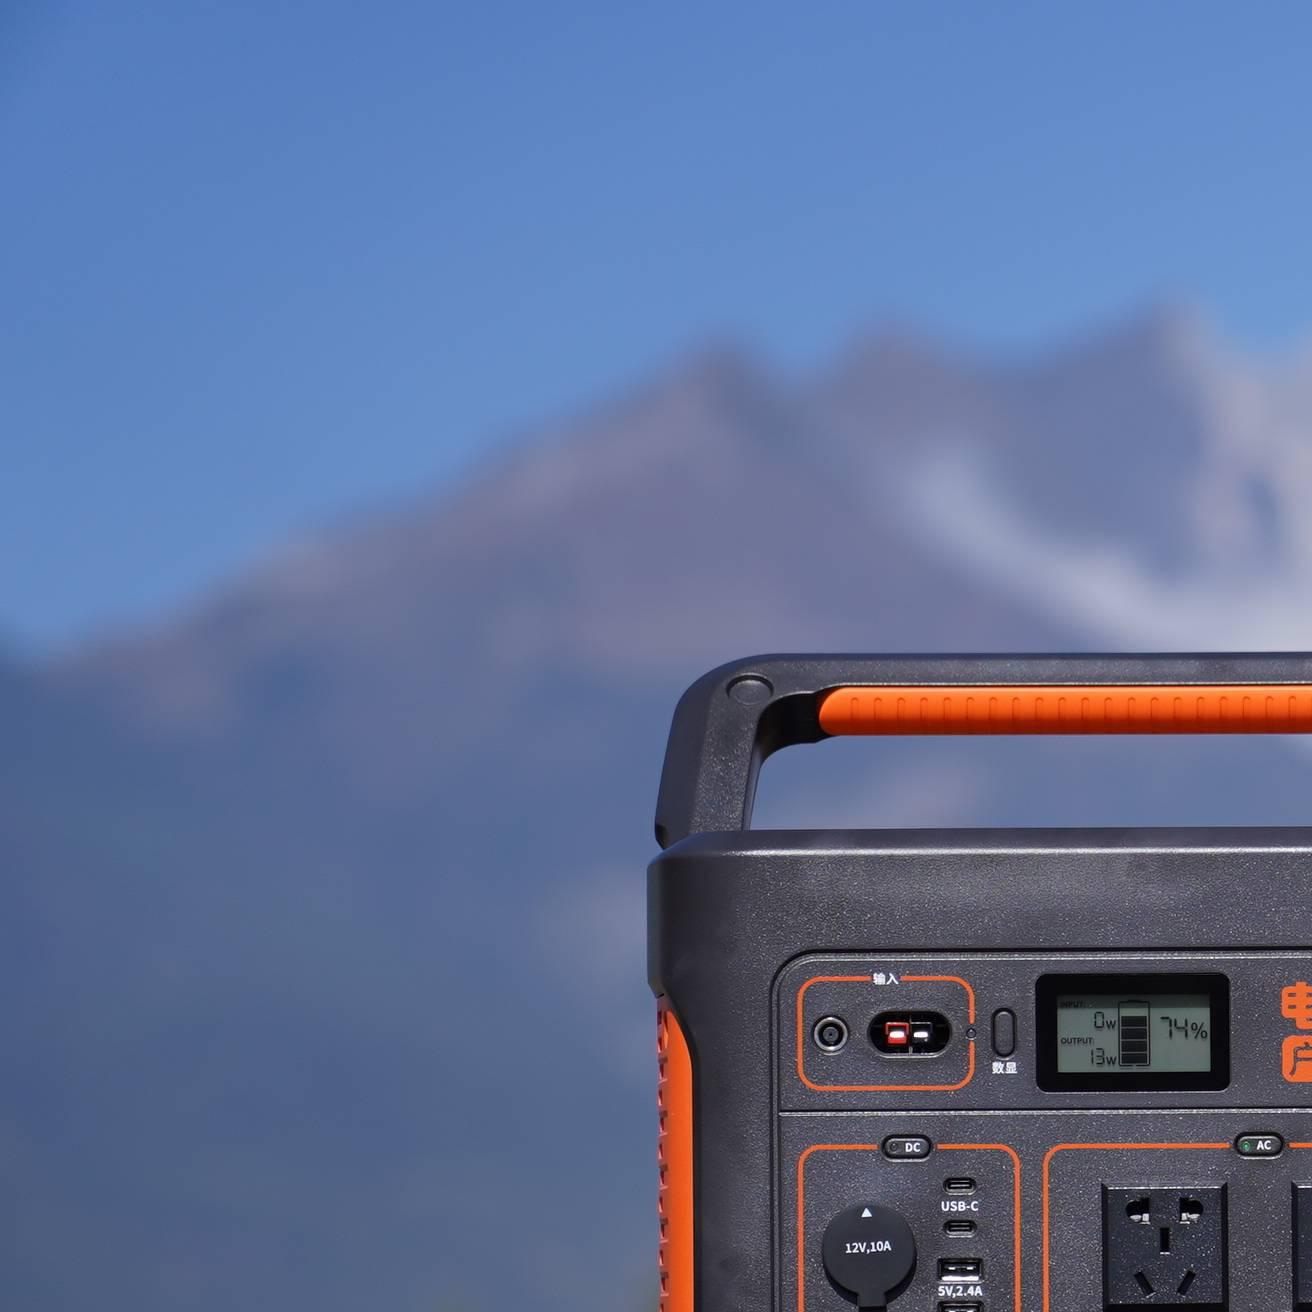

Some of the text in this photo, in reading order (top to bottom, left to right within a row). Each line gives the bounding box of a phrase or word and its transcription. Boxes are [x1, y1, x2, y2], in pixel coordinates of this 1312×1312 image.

[872, 972, 900, 986] 输入
[1159, 1016, 1209, 1041] 74%
[991, 1061, 1018, 1075] 数显
[905, 1142, 921, 1153] DC
[1255, 1139, 1272, 1151] AC
[941, 1200, 979, 1212] USB-C
[844, 1240, 892, 1255] 12V,10A
[937, 1286, 983, 1298] 5V,2.4A
